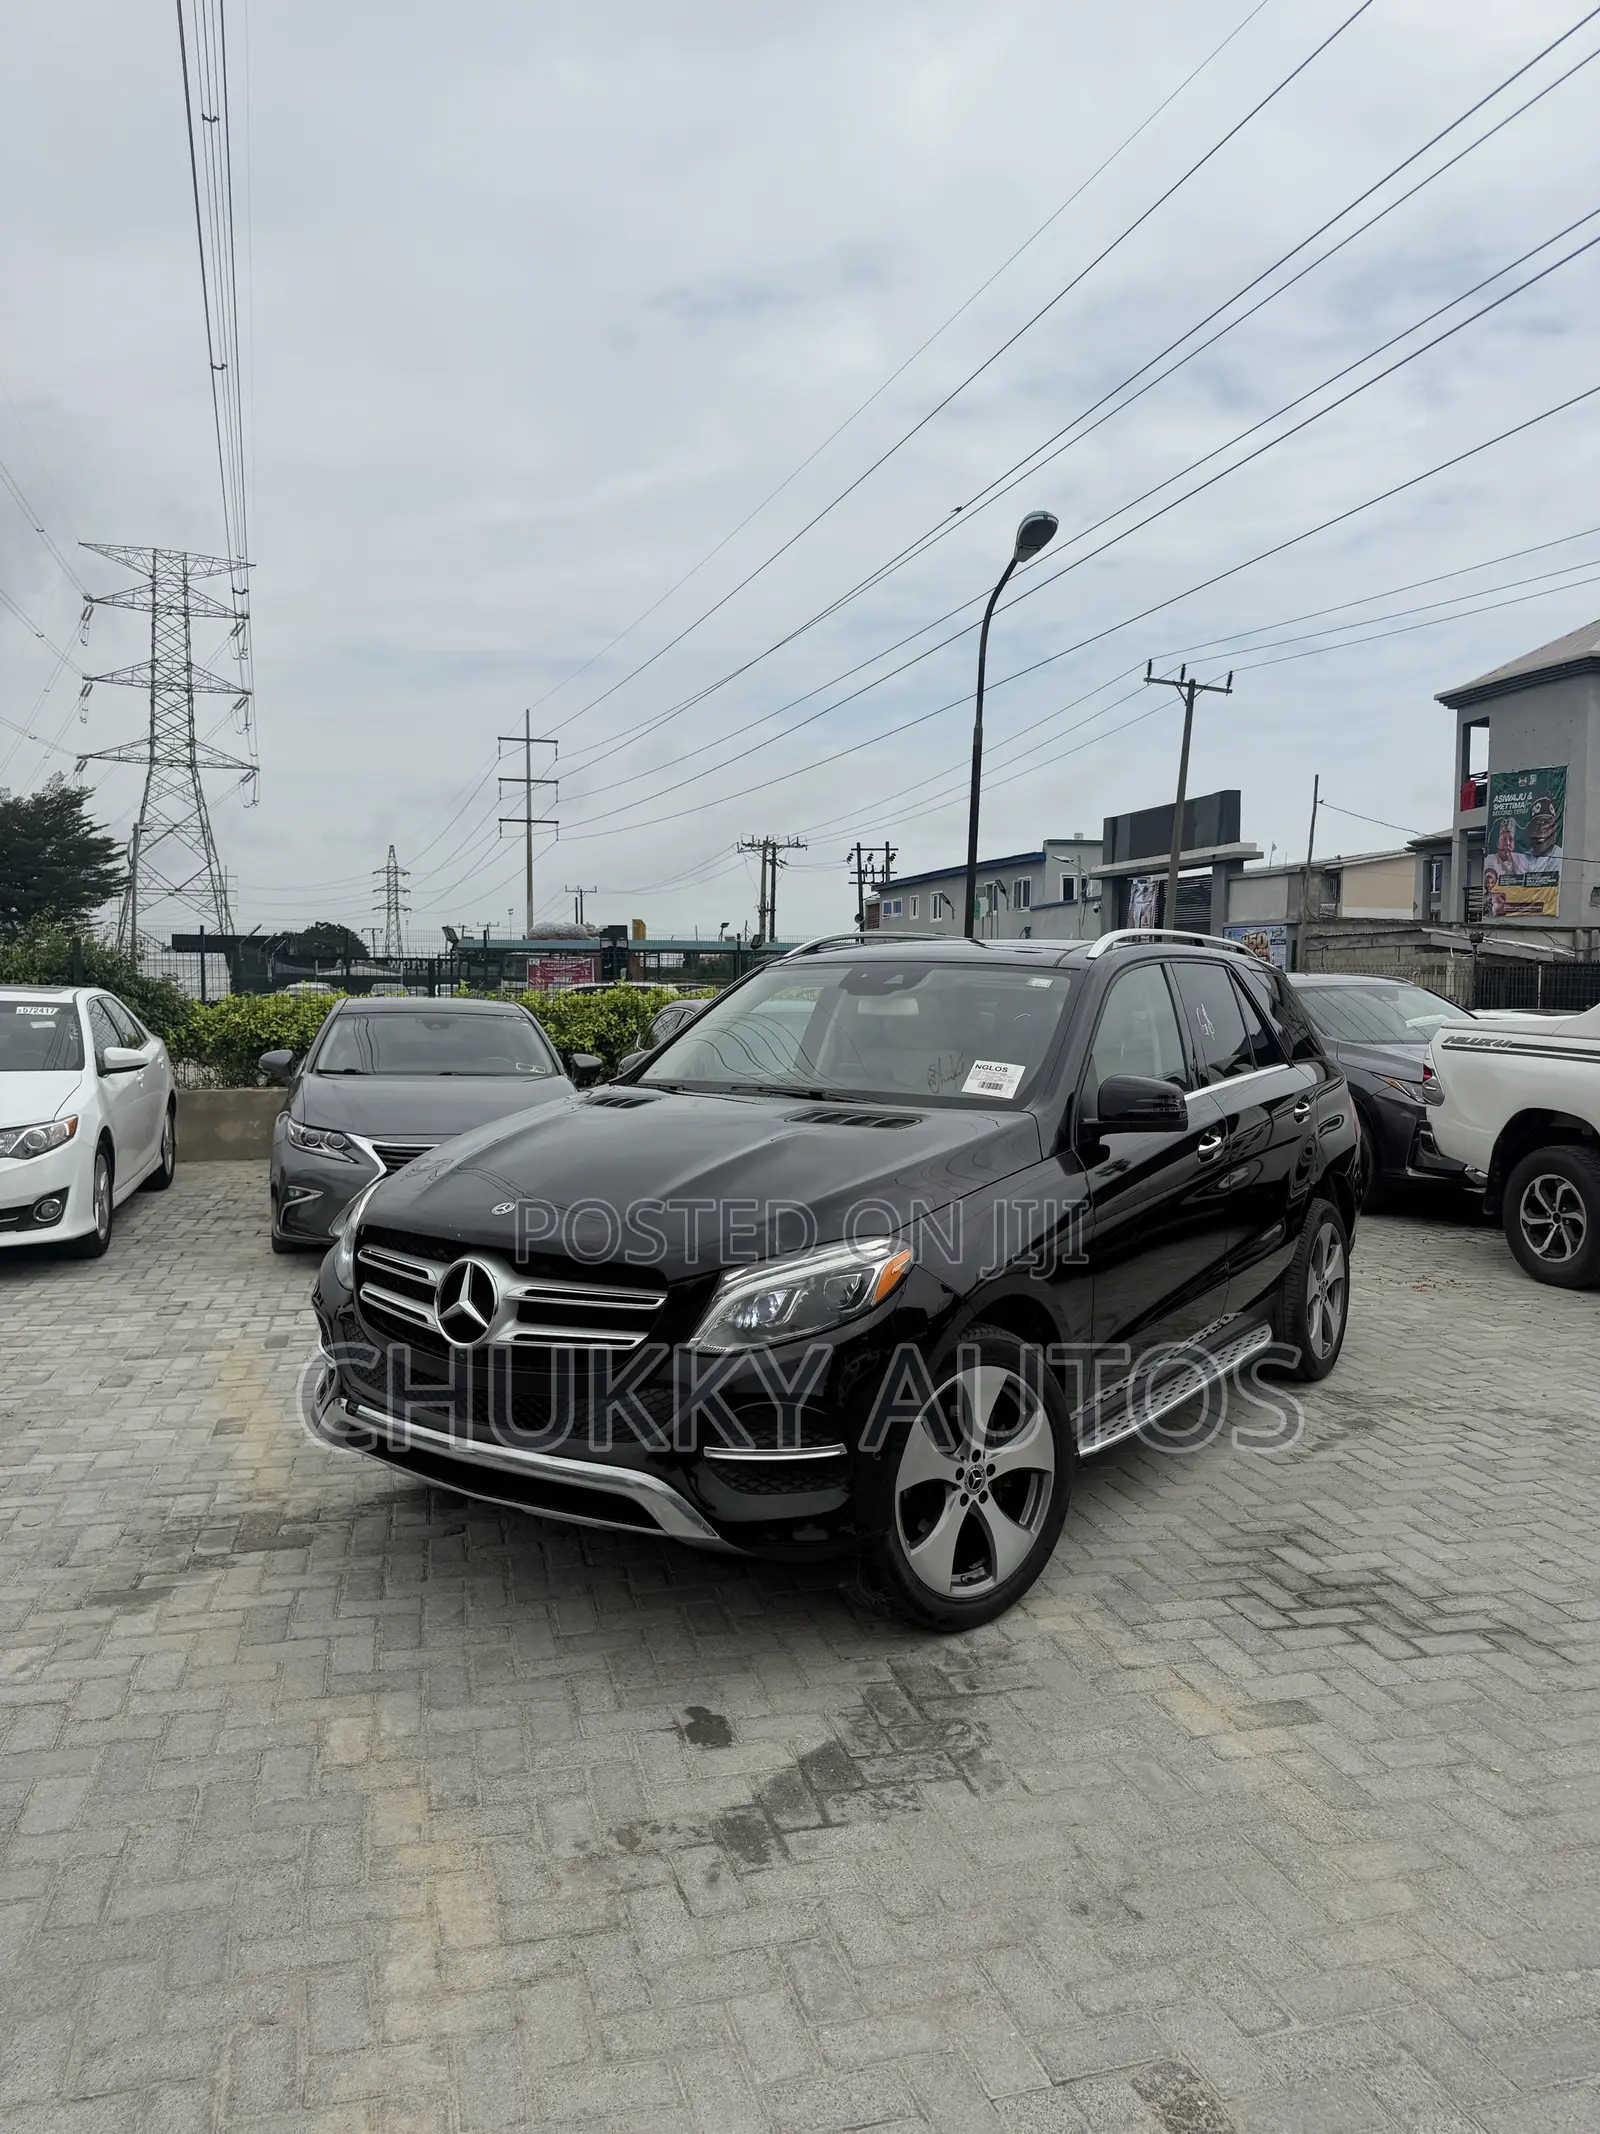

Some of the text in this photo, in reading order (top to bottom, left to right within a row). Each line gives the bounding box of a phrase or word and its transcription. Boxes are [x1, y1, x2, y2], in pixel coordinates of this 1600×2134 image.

[1493, 793, 1526, 802] ASIWAJU
[1493, 802, 1525, 810] SHETTIMA
[975, 1064, 1009, 1072] NGLOS
